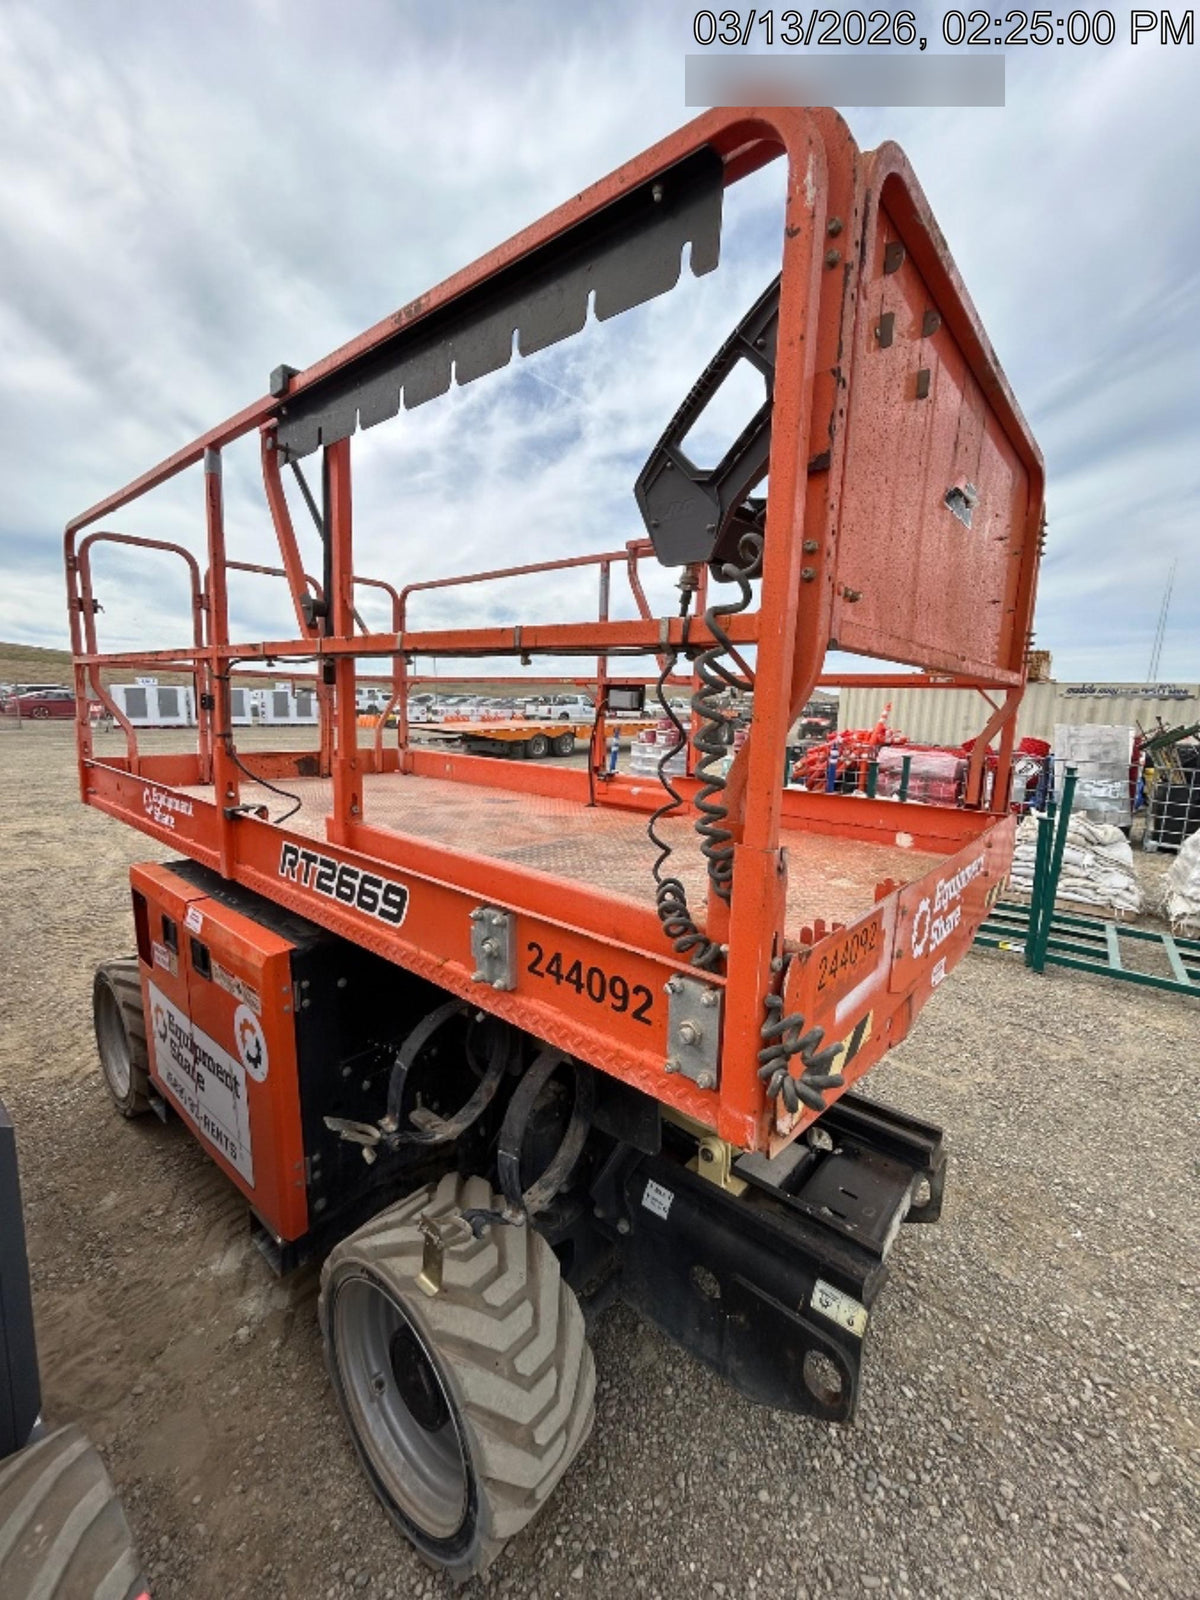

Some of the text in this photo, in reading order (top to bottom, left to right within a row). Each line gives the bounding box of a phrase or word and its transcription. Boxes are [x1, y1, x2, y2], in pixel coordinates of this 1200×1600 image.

[153, 805, 175, 829] Share
[279, 841, 410, 929] RT2669
[817, 921, 878, 991] 244092
[929, 905, 961, 952] Share
[527, 942, 653, 1026] 244092
[167, 1009, 240, 1099] Equipment
[169, 1037, 205, 1092] Share
